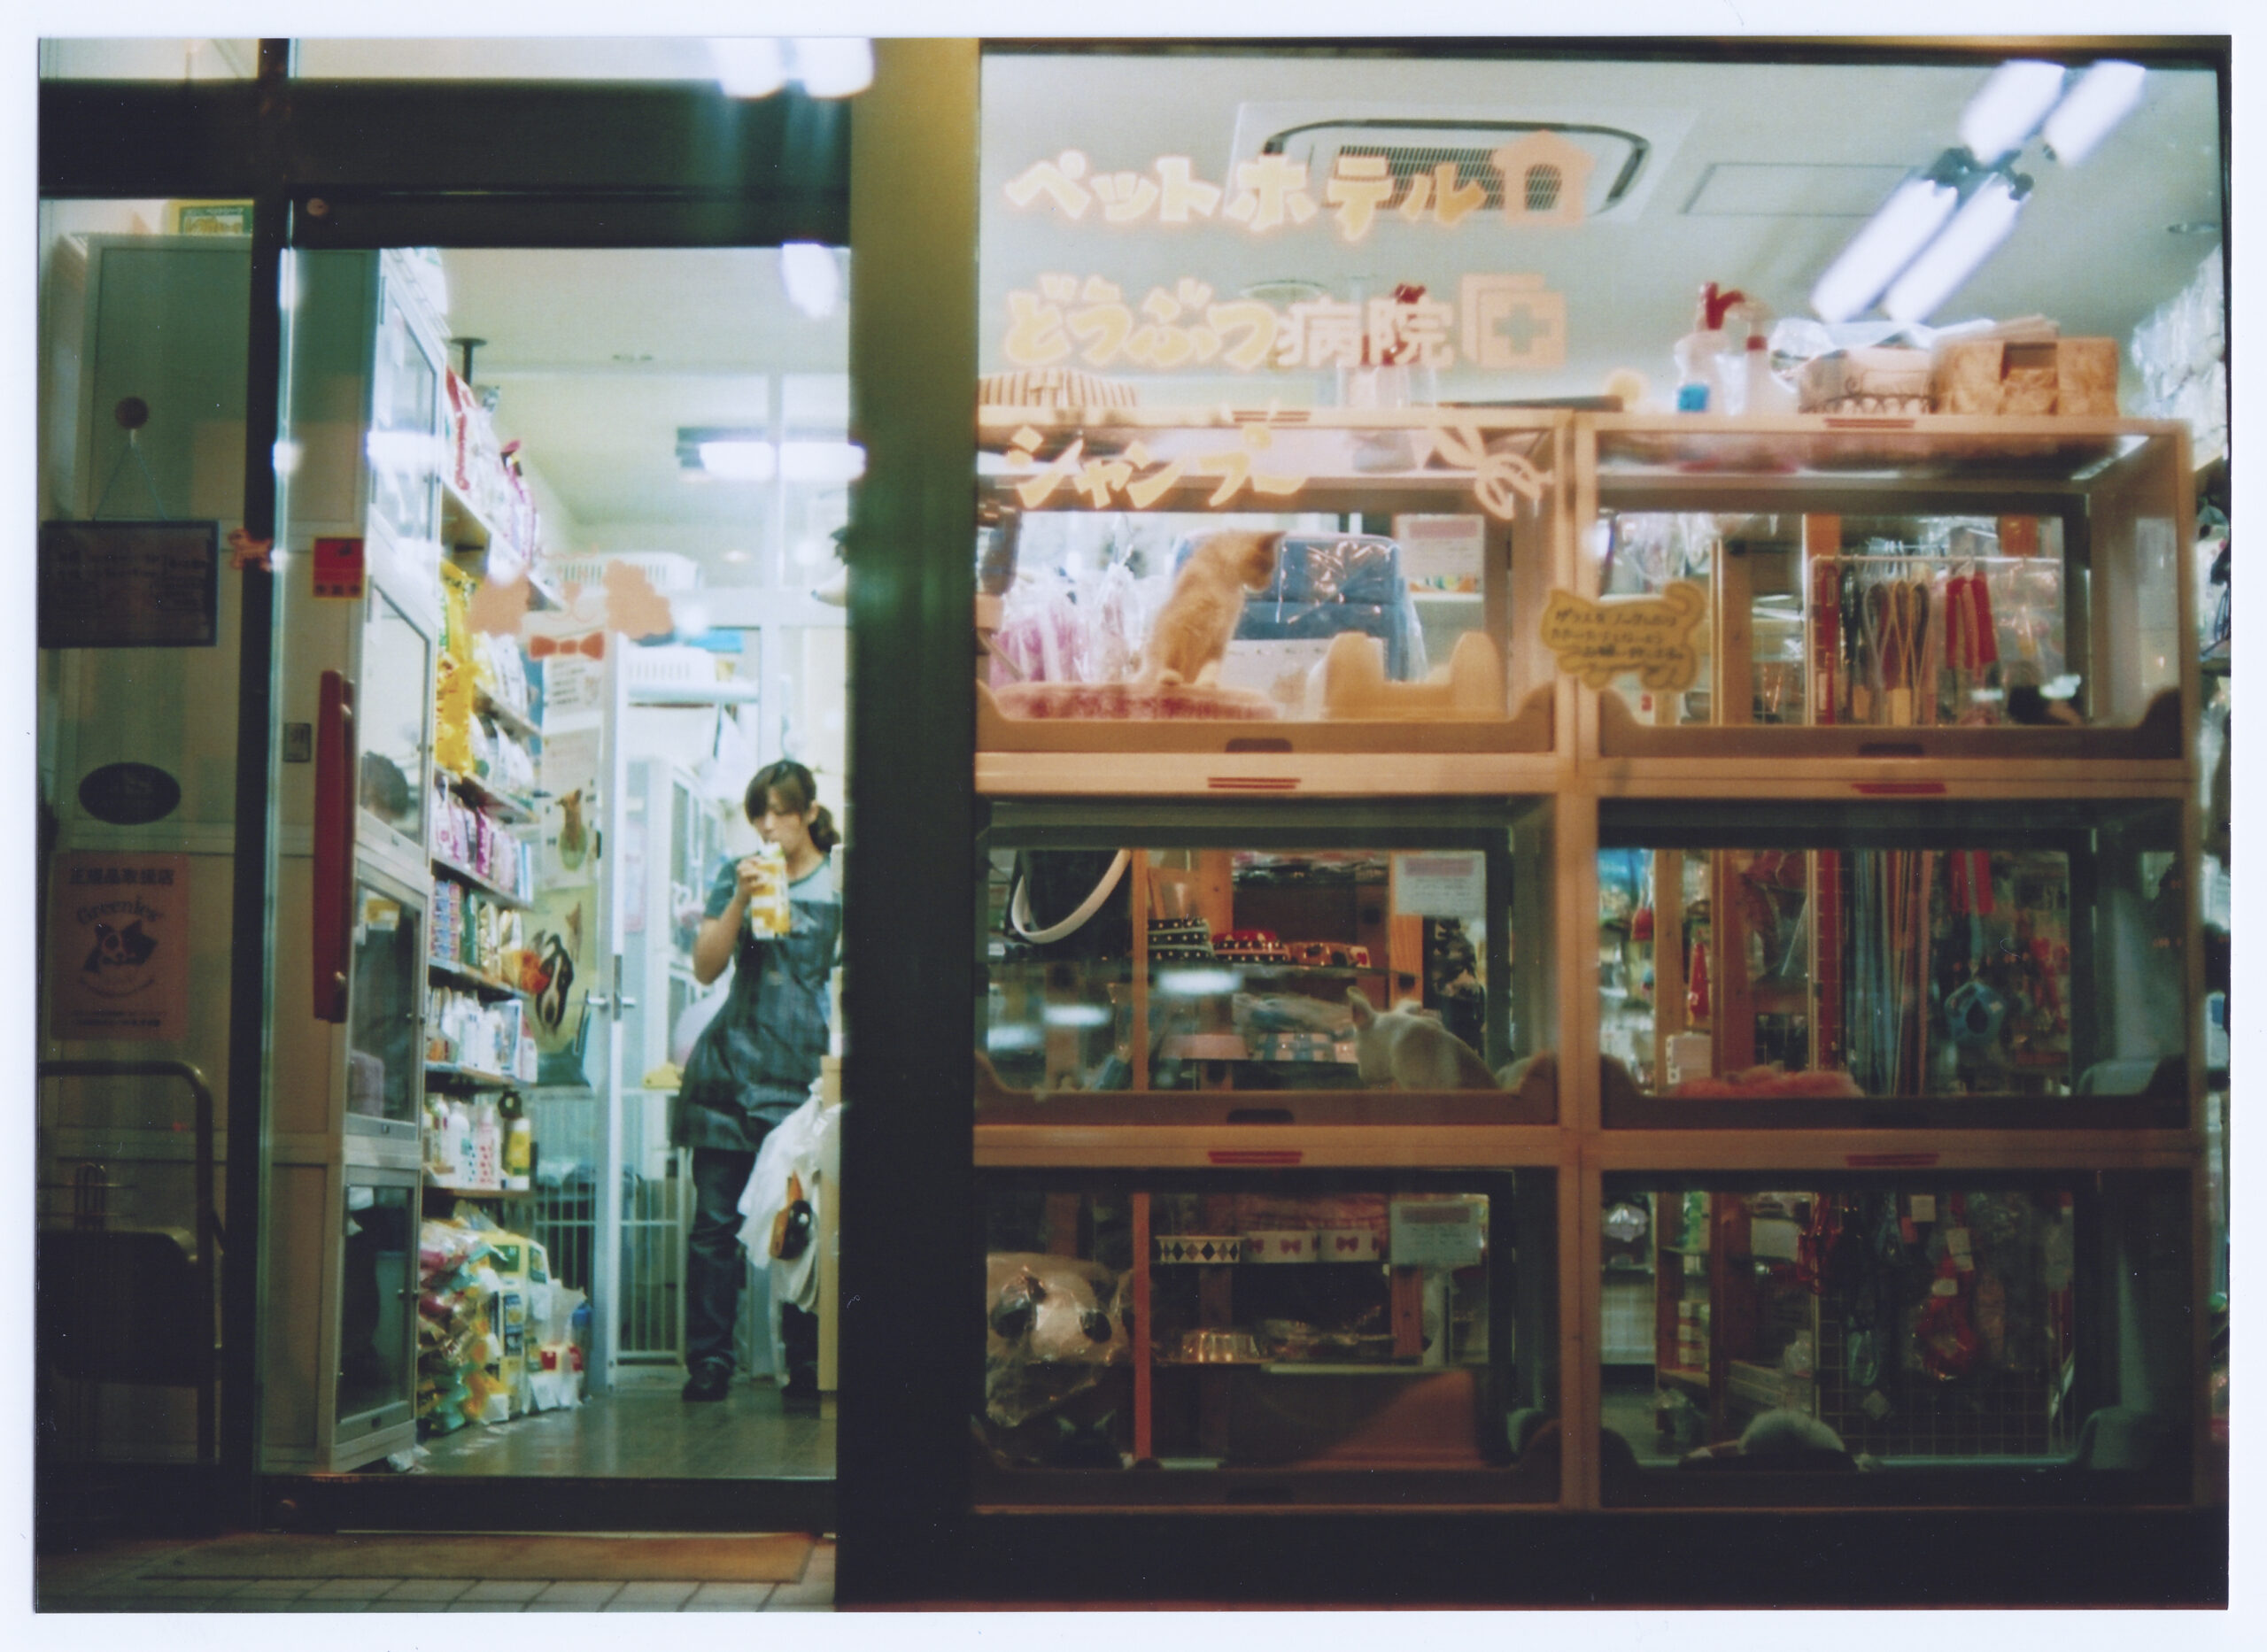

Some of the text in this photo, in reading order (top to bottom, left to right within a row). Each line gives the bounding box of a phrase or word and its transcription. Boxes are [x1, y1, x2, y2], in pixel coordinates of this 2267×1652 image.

[1003, 151, 1486, 241] ペットホテル
[1004, 274, 1453, 368] どうぶつ病院
[1005, 424, 1308, 508] シャンプー
